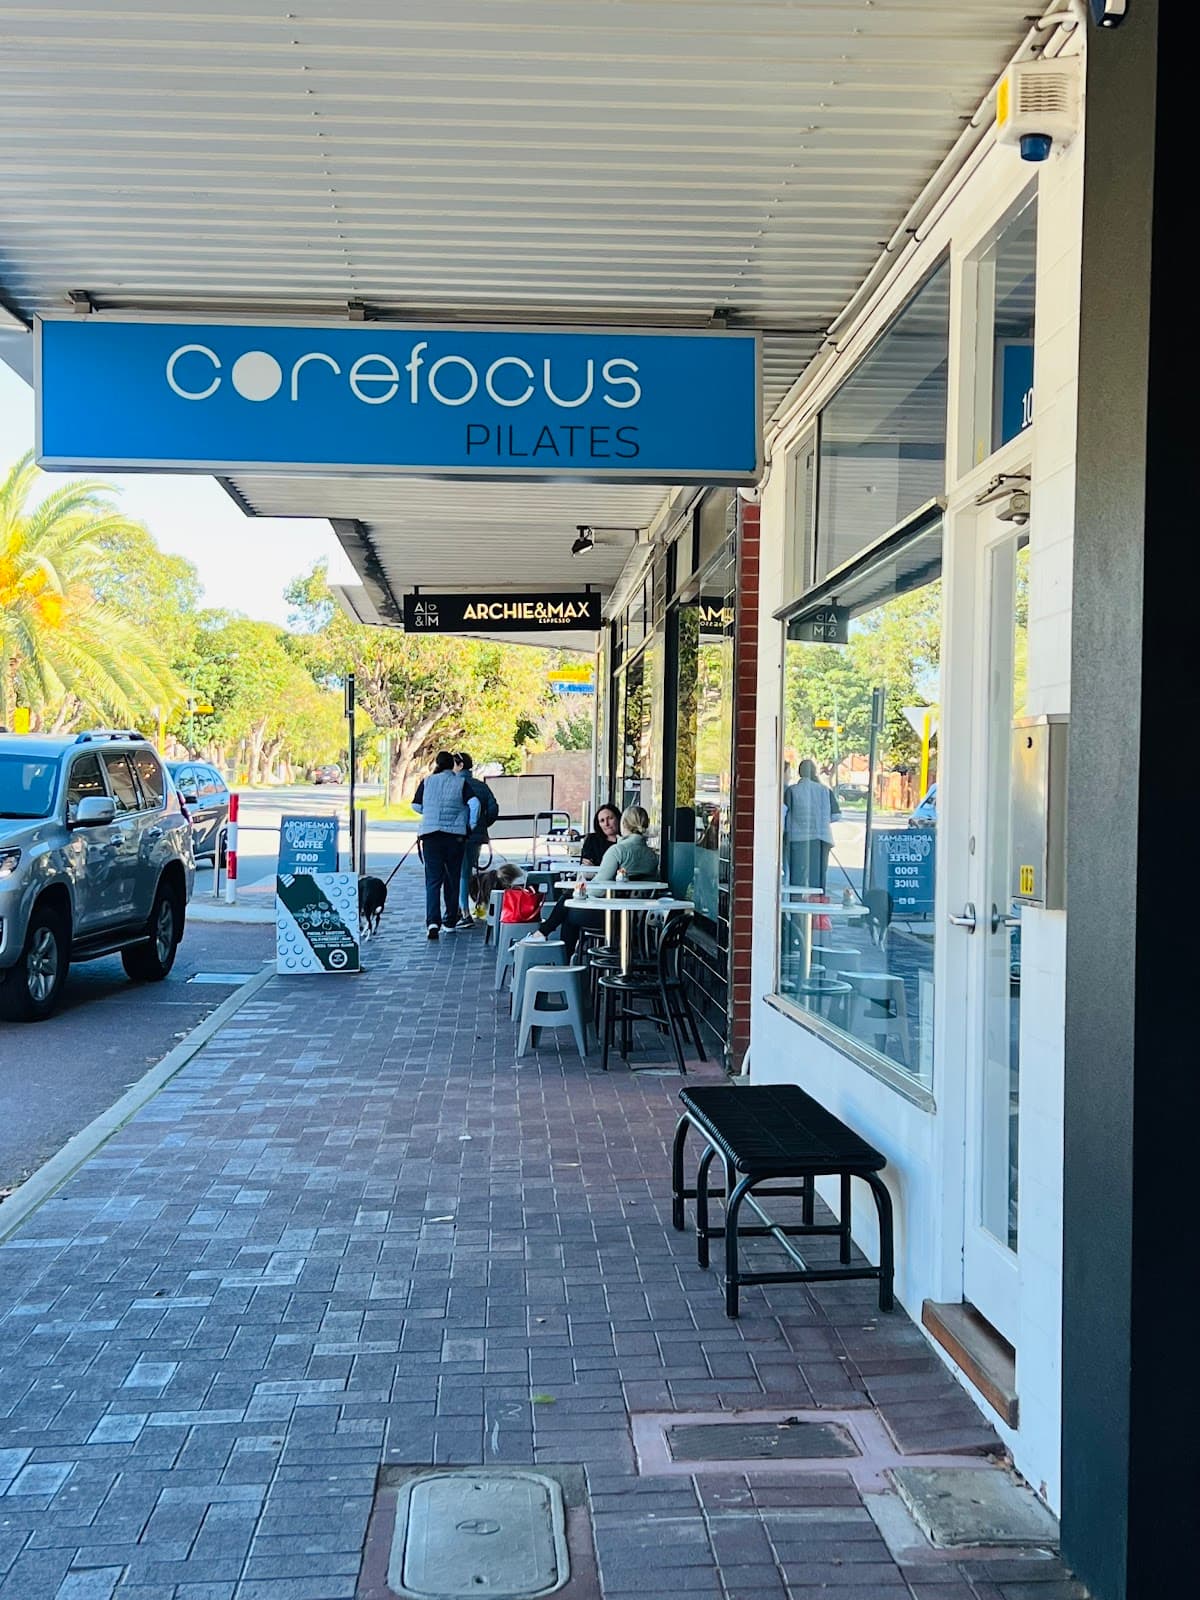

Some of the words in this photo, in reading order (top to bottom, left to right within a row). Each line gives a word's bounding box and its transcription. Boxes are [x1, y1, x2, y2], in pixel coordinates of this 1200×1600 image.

[165, 341, 642, 409] corefocus
[465, 423, 641, 459] PILATES
[463, 602, 590, 619] ARCHIE&MAX
[293, 840, 323, 848] COFFEE
[296, 853, 318, 861] FOOD
